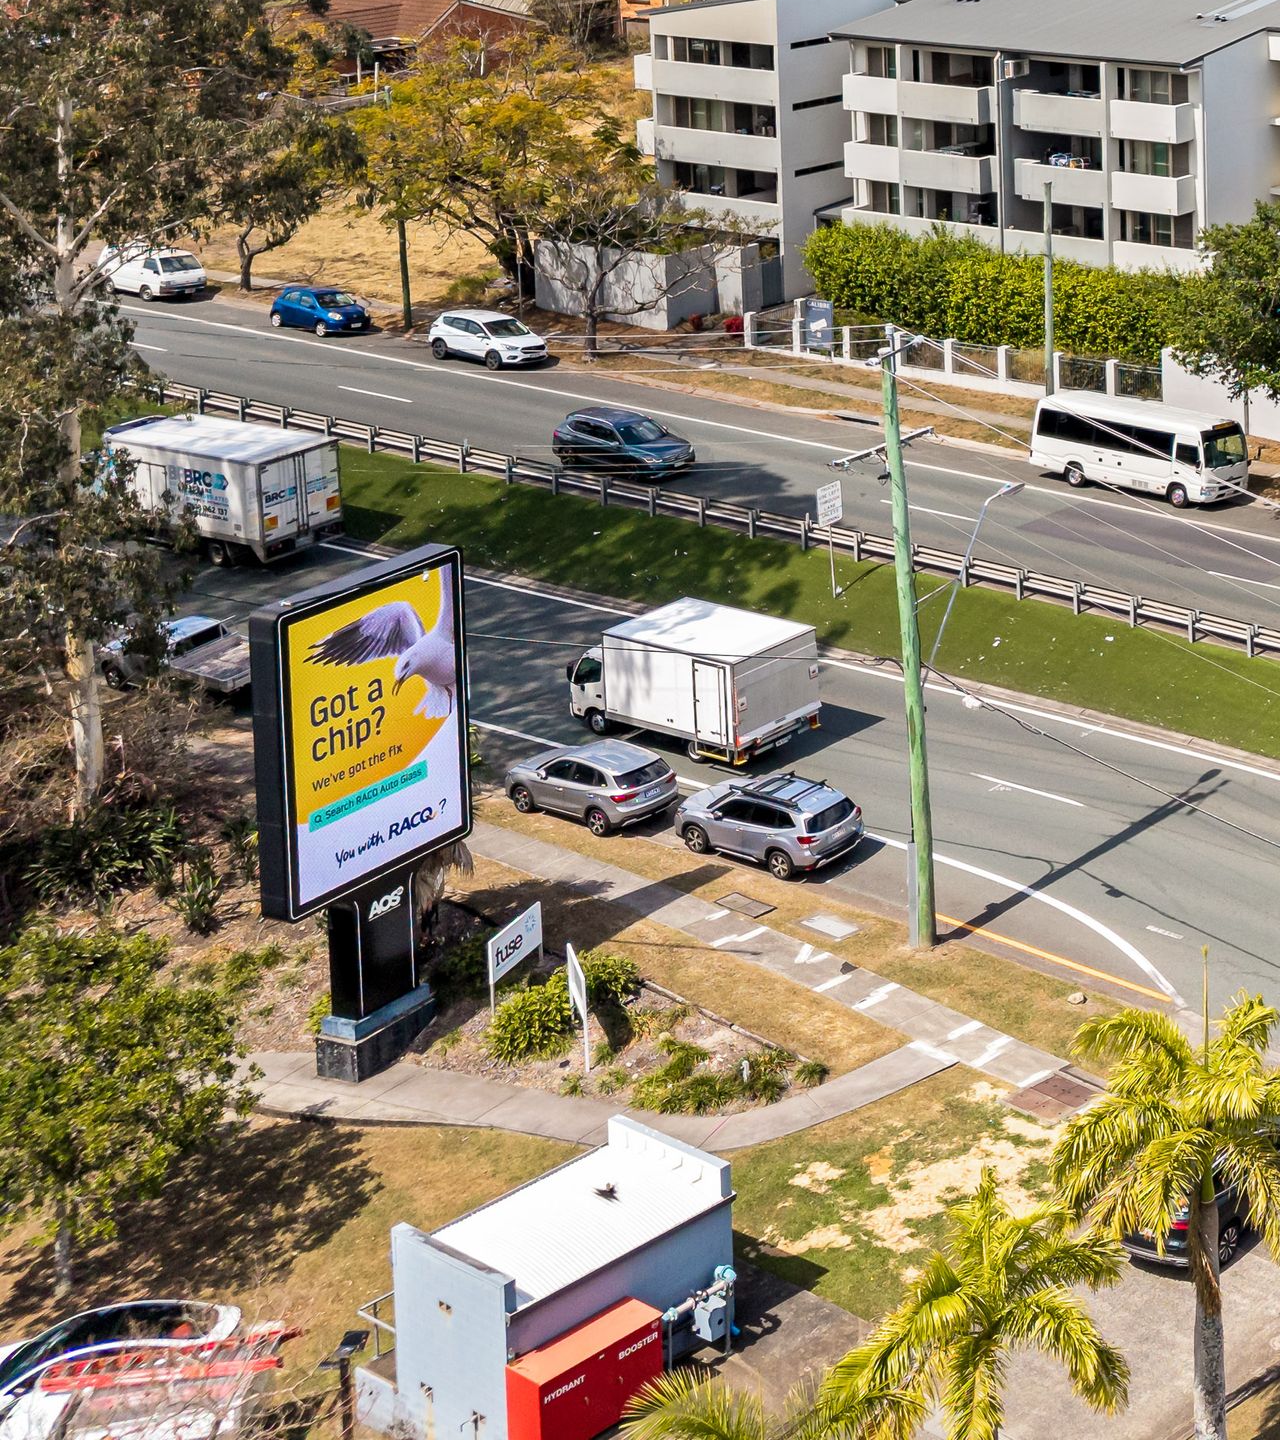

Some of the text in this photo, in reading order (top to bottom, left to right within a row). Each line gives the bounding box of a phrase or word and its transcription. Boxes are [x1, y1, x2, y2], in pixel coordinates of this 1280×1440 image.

[184, 468, 213, 488] BRC
[265, 489, 286, 503] BRC
[310, 678, 383, 727] Got a
[312, 705, 386, 762] chip?
[312, 743, 403, 792] We've got the fix
[325, 799, 354, 820] Search
[380, 779, 399, 793] Auto
[400, 768, 422, 784] Glass
[335, 848, 356, 869] You
[357, 831, 385, 855] with
[388, 806, 436, 841] RACQ
[495, 934, 523, 968] fuse
[618, 1331, 658, 1361] BOOSTER
[543, 1374, 586, 1405] HYDRANT
